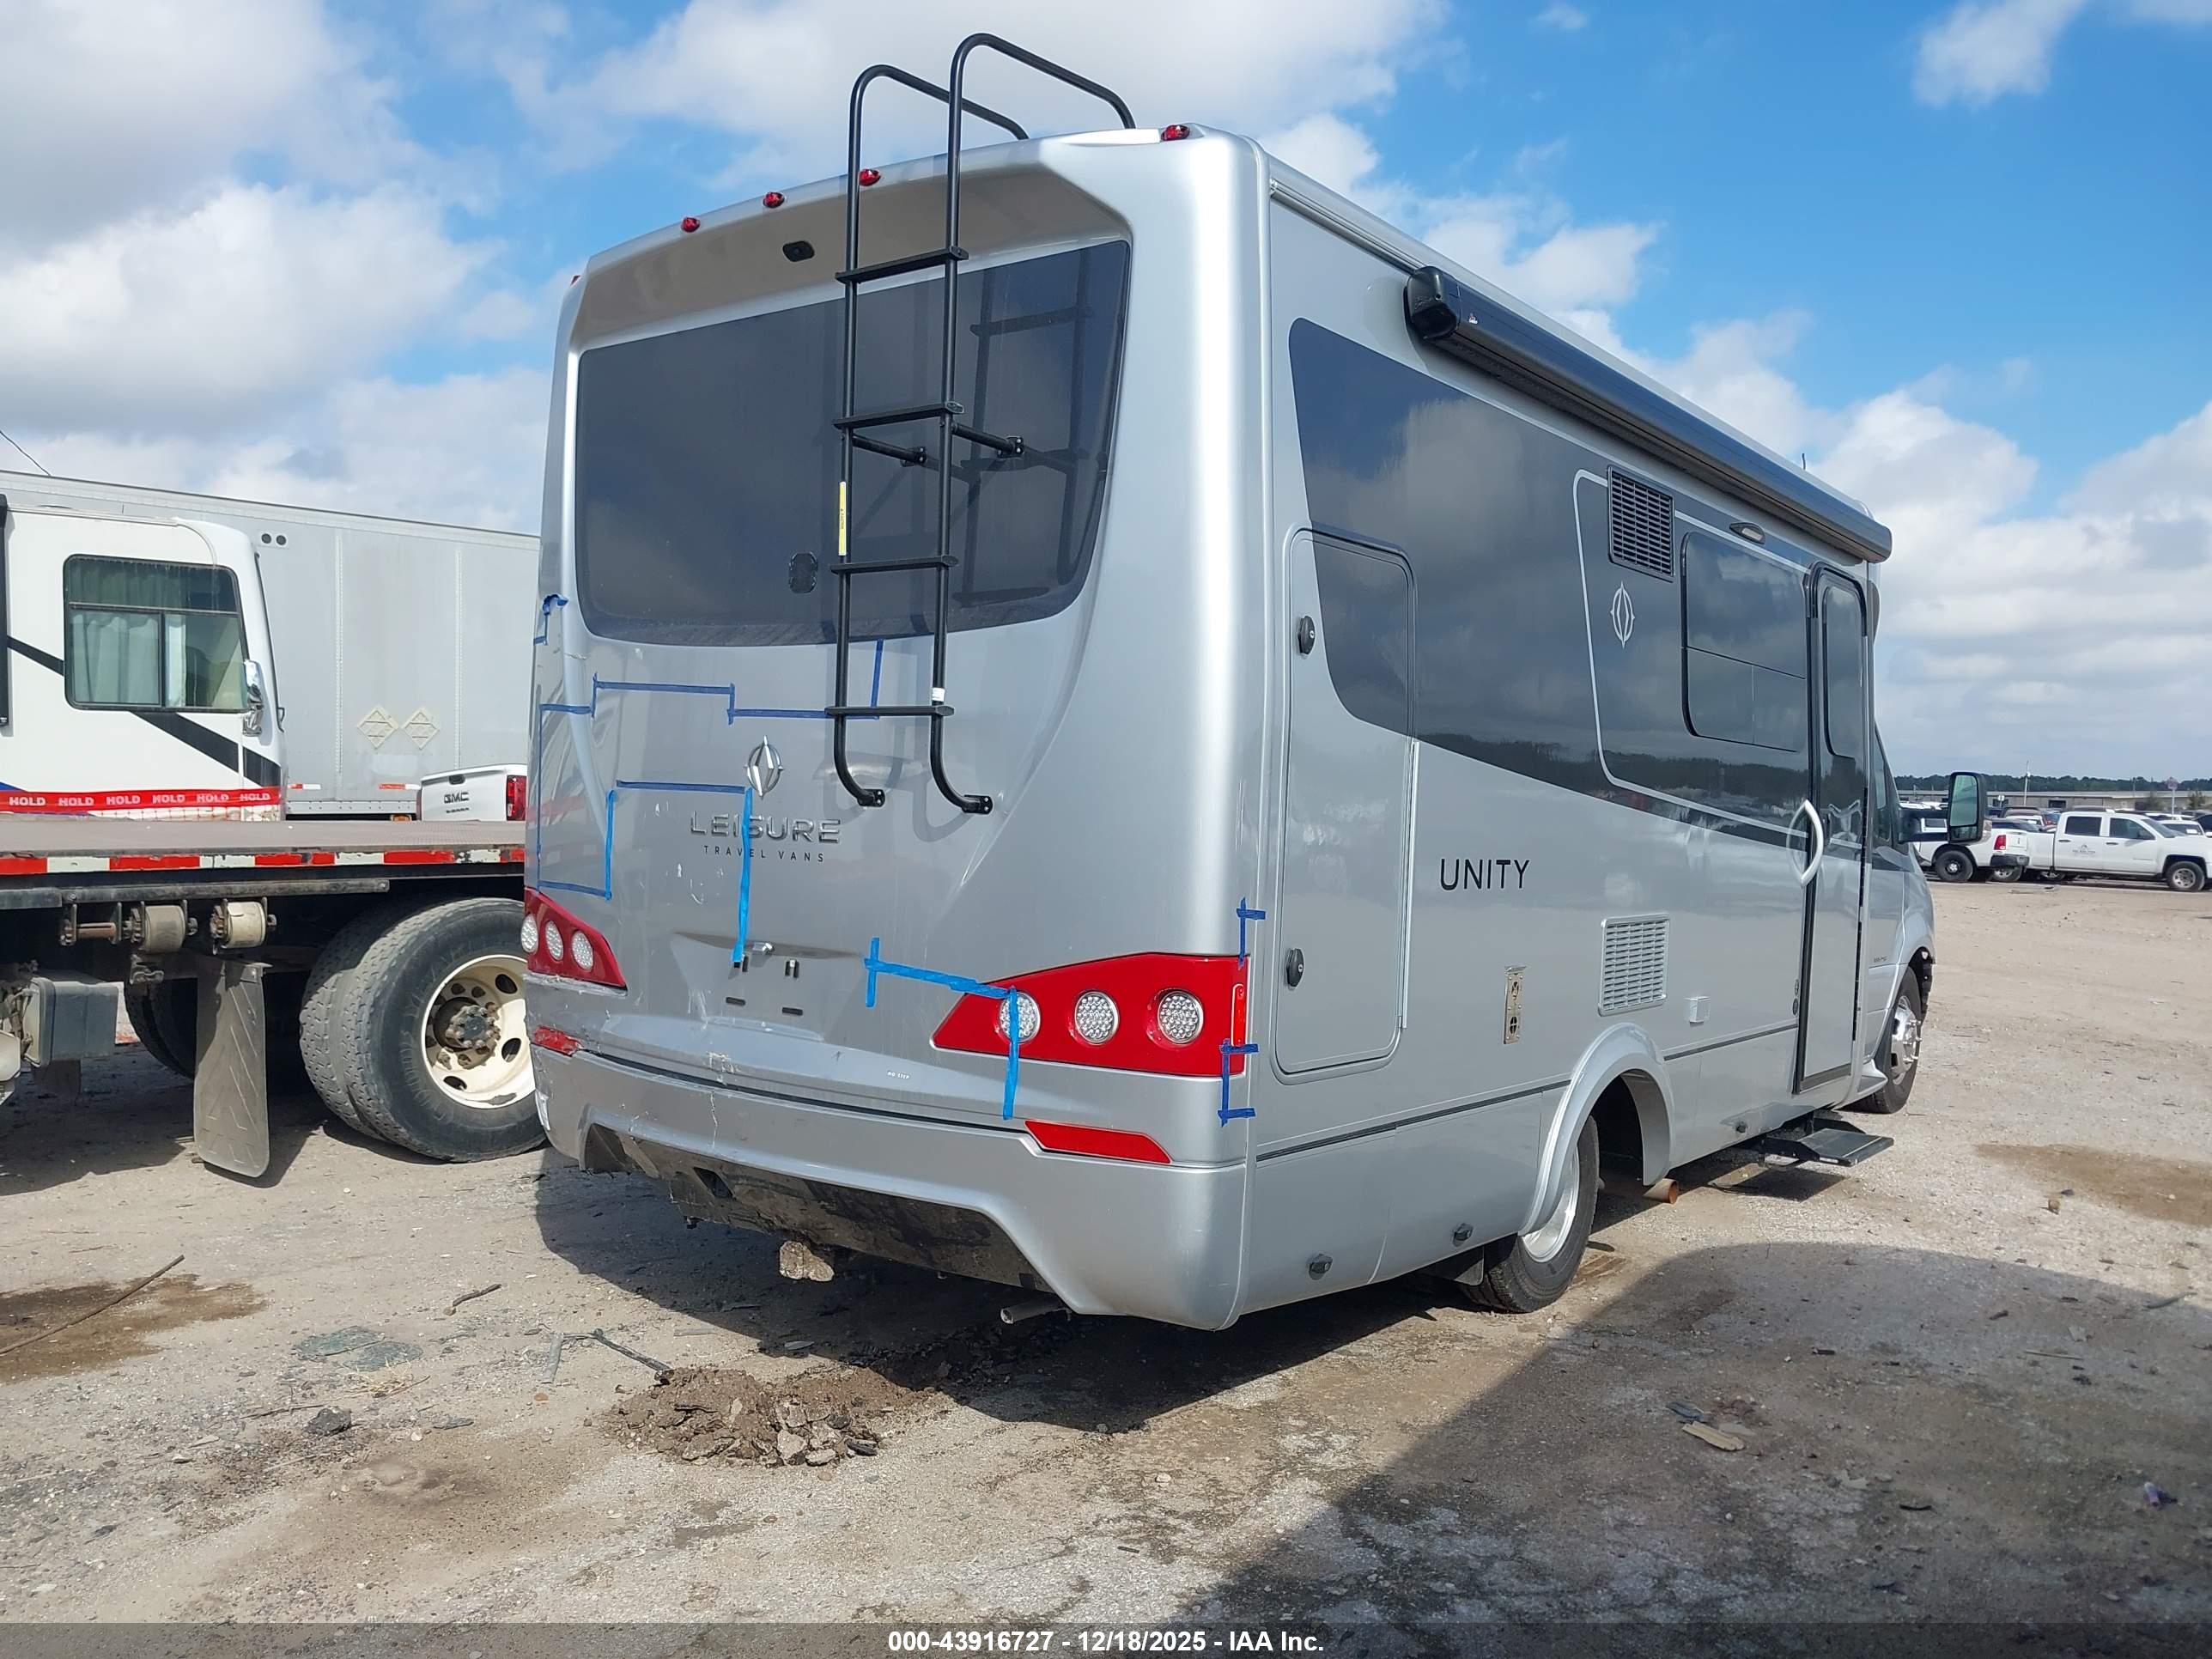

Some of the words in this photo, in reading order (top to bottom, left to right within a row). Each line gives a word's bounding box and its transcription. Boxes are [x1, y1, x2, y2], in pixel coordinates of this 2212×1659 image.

[9, 796, 46, 806] HOLD
[58, 797, 94, 806] HOLD
[106, 795, 141, 805] HOLD
[152, 794, 185, 804] HOLD
[196, 793, 229, 803] HOLD
[240, 793, 271, 802] HOLD
[444, 792, 469, 804] GMC
[690, 811, 841, 844] LEISURE
[703, 846, 766, 859] TRAVEL
[778, 851, 824, 862] VANS
[1440, 858, 1530, 891] UNITY
